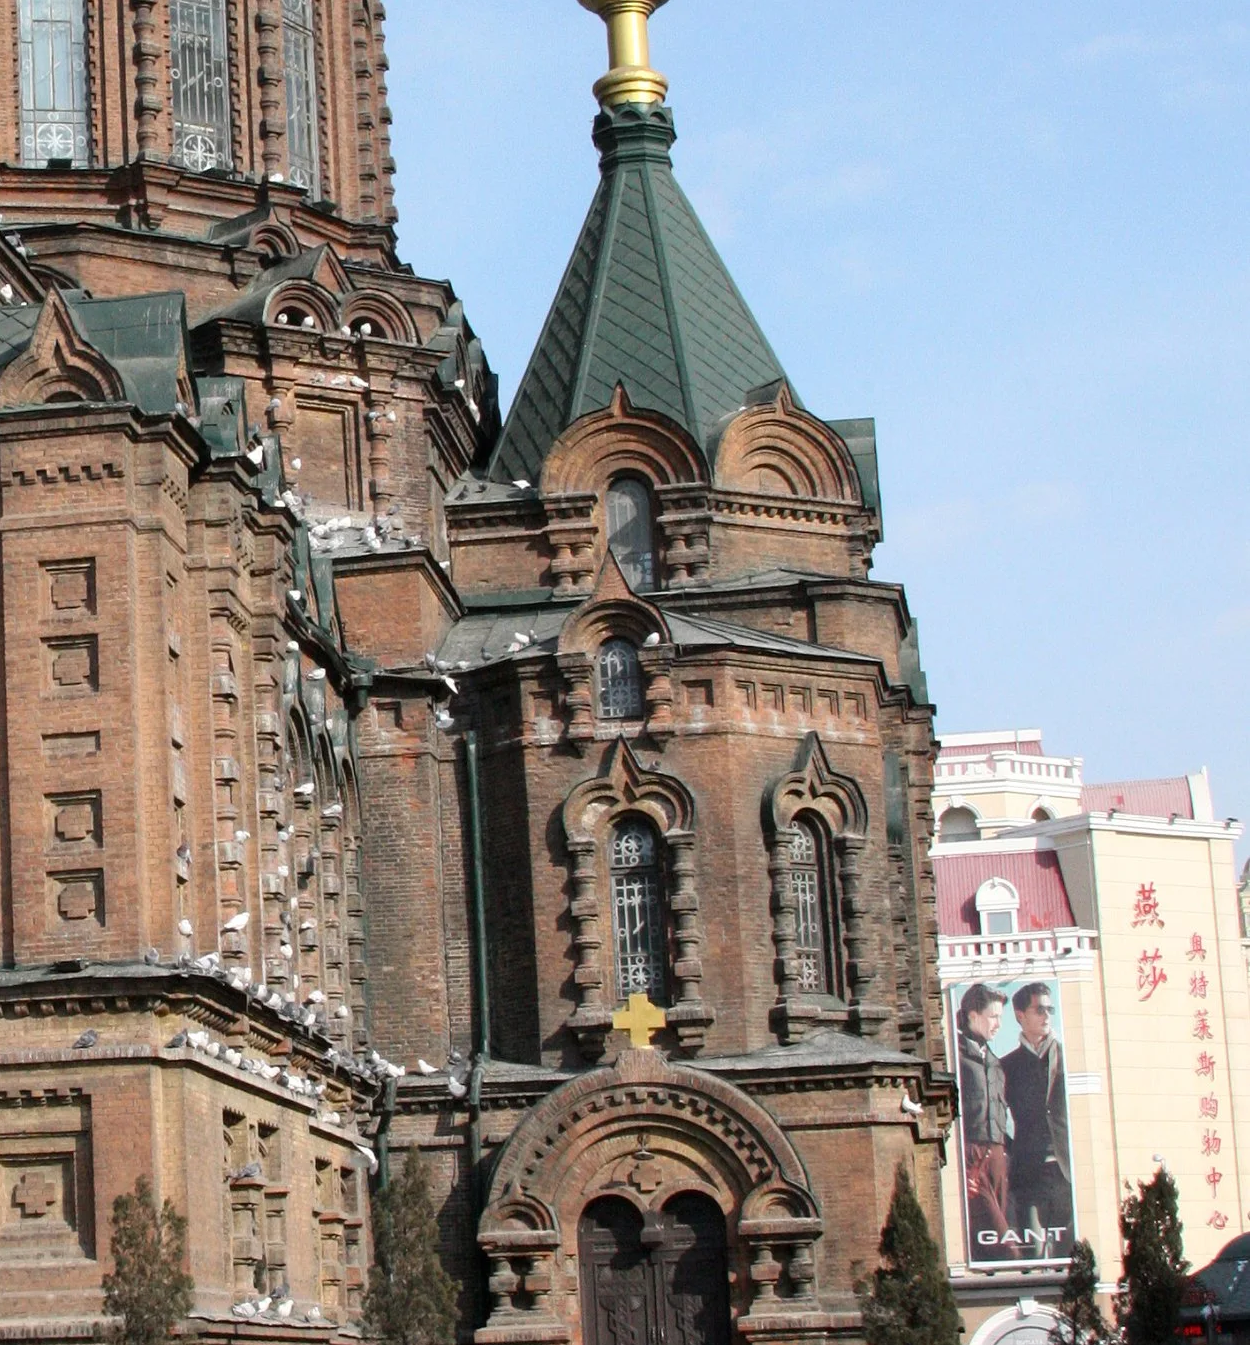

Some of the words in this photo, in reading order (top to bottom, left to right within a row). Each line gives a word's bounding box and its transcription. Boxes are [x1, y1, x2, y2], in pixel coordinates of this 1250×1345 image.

[1130, 881, 1168, 1002] 燕莎
[1185, 932, 1229, 1230] 奥特莱斯购物中心
[977, 1226, 1068, 1245] GANT
